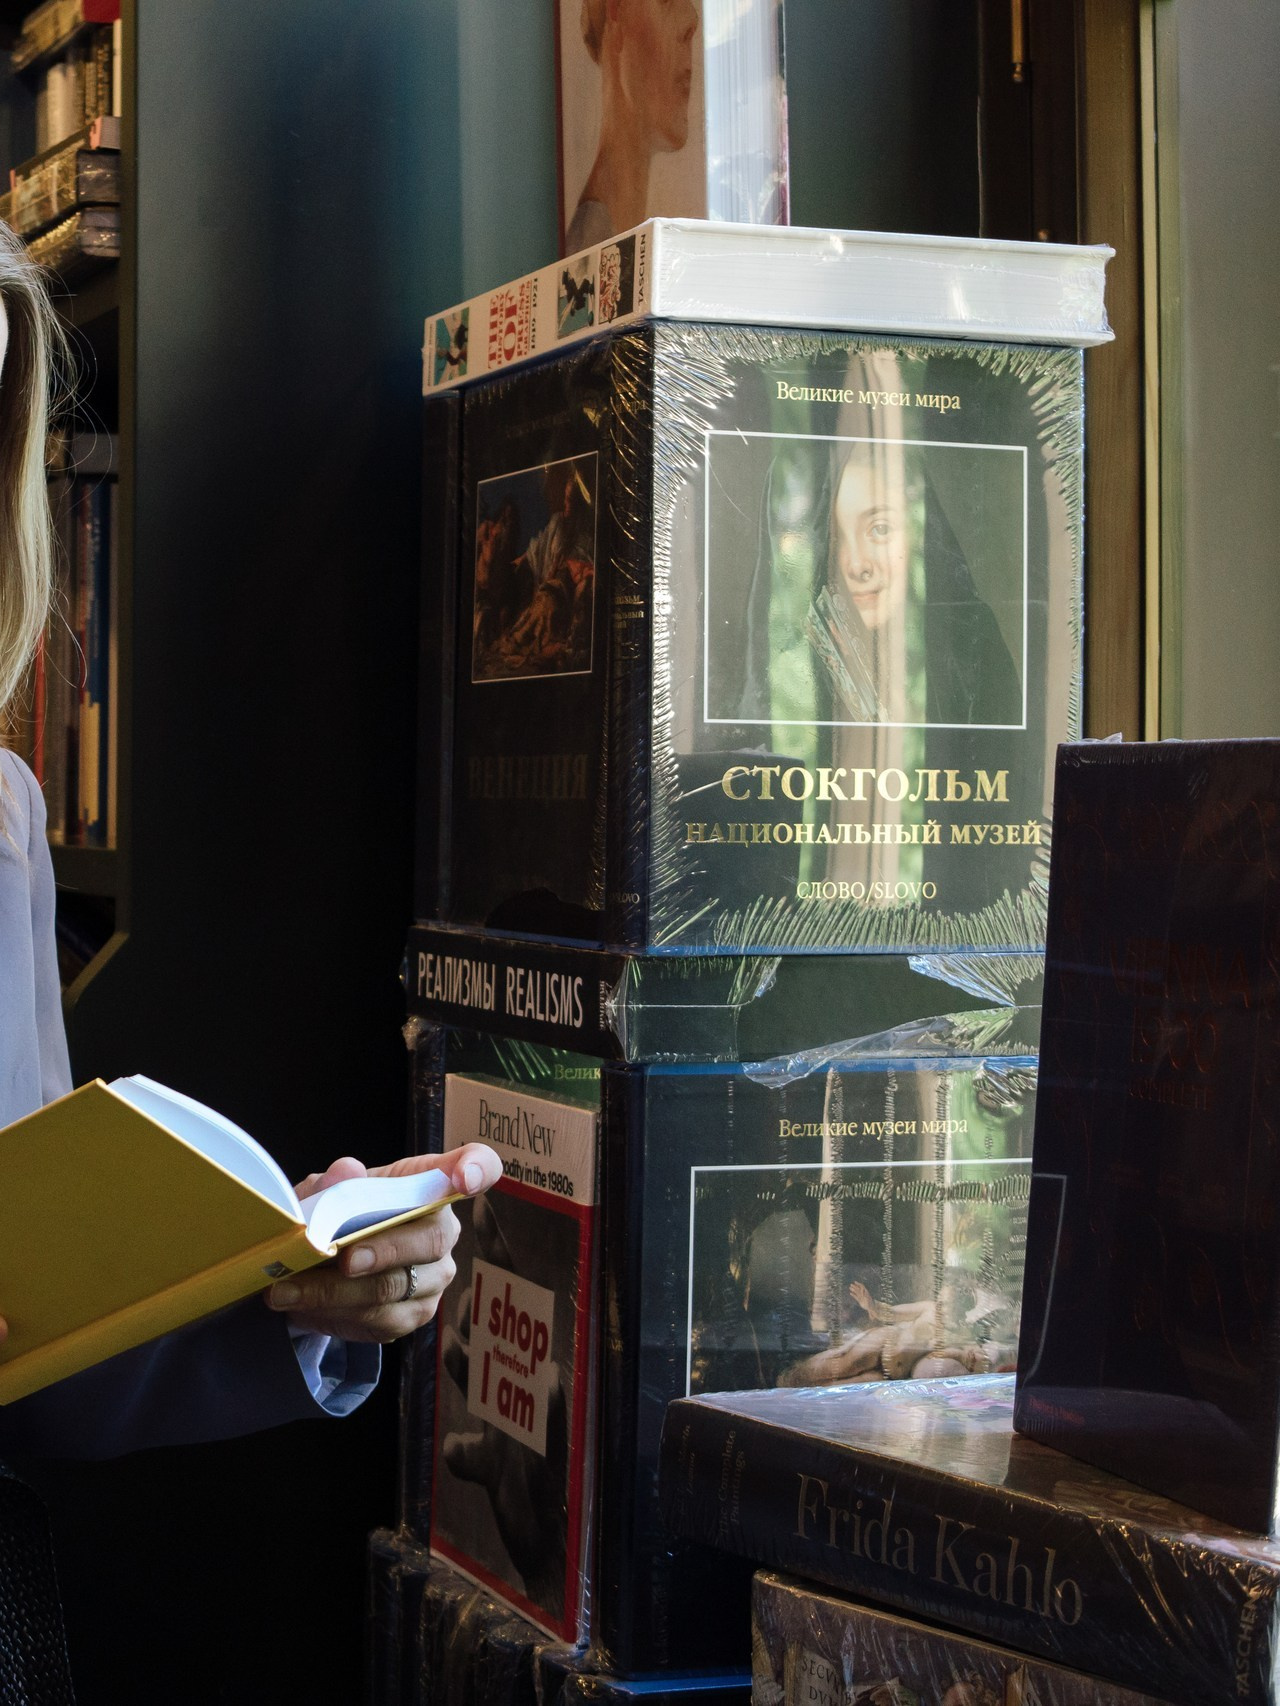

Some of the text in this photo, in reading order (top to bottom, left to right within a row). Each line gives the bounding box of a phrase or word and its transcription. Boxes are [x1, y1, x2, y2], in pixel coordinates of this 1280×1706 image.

[637, 233, 646, 306] TASCHEN
[487, 294, 499, 369] THE
[497, 292, 505, 366] HISTORY
[503, 289, 517, 362] OF
[516, 282, 526, 357] PRESS
[776, 381, 961, 413] Великие музеи мира
[721, 764, 1011, 803] СТОКГОЛЬМ
[685, 819, 1042, 848] НАЦИОНАЛЬНЫЙ МУЗЕЙ
[796, 881, 937, 903] СЛОВО/SLOVO
[417, 951, 583, 1029] РЕАЛИЗМЫ REALISMS
[554, 1064, 600, 1080] Велик
[478, 1099, 556, 1158] Brand New
[778, 1119, 968, 1140] Великие музеи мира
[501, 1158, 574, 1196] odity in the 1980s
[472, 1272, 549, 1375] I shop
[480, 1351, 535, 1433] I am
[492, 1344, 529, 1378] therefore
[717, 1429, 737, 1502] Complete
[729, 1449, 746, 1526] Paintings
[791, 1473, 1083, 1627] Frida Kahlo
[1235, 1593, 1261, 1698] TASCHEN
